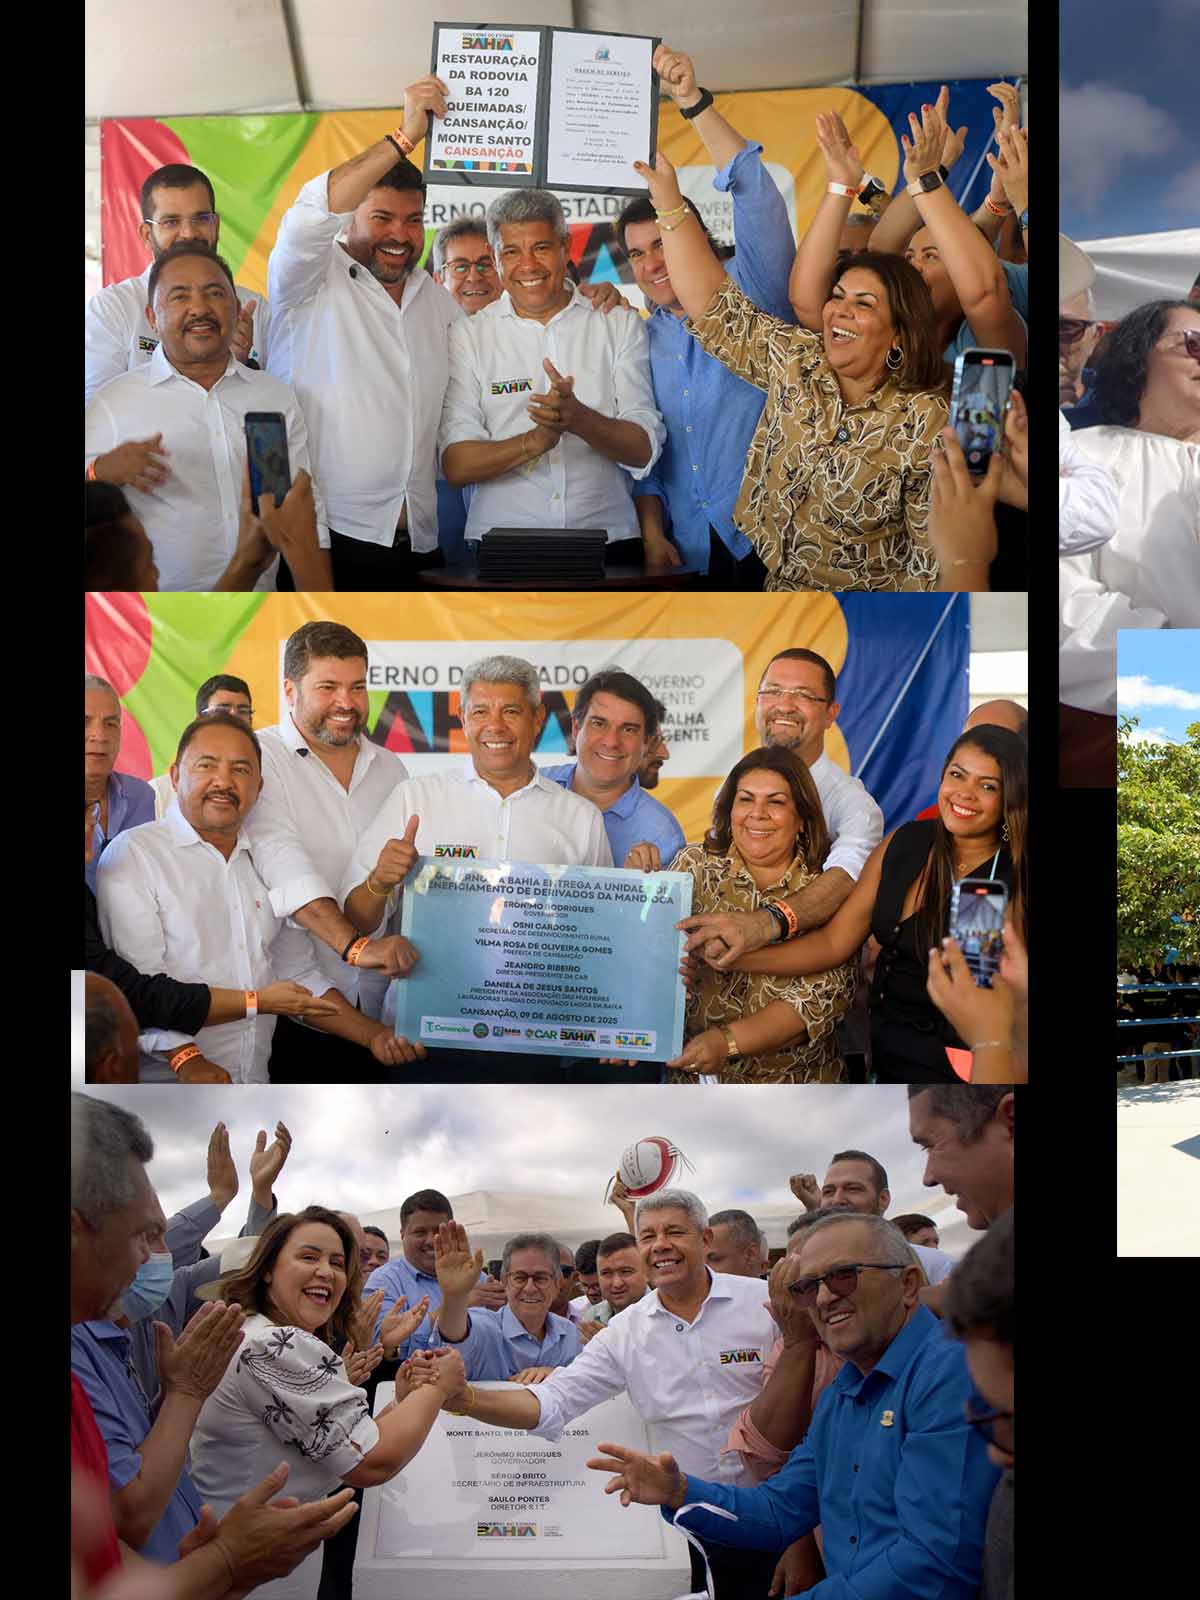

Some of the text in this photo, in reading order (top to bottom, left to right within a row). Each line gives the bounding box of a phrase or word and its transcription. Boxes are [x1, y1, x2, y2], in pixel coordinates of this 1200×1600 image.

[462, 37, 513, 50] BAHIA
[442, 54, 537, 67] RESTAURAÇÃO
[449, 70, 528, 82] DA RODOVIA
[465, 86, 510, 97] BA 120
[447, 102, 527, 114] QUEIMADAS/
[443, 118, 528, 131] CANSANÇÃO/
[437, 134, 532, 146] MONTE SANTO
[444, 146, 524, 159] CANSANÇÃO
[369, 666, 439, 685] ERNO
[640, 674, 705, 688] OVERNO
[434, 847, 480, 858] BAHIA
[507, 876, 540, 887] BAHIA
[594, 882, 601, 890] A
[428, 880, 674, 905] ENEFICIAMENTO DE DERIVADOS DA MANDOCA
[512, 921, 578, 932] OSNI CARDOSO
[503, 940, 526, 949] ROSA
[541, 943, 580, 952] OLIVEIRA
[582, 946, 613, 954] GOMES
[504, 961, 546, 970] JEANDRO
[484, 980, 598, 994] DANIELA DE JESUS SANTOS
[520, 1010, 530, 1018] 09
[531, 1012, 543, 1020] DE
[546, 1013, 582, 1022] AGOSTO
[584, 1015, 597, 1023] DE
[597, 1016, 619, 1025] 2025
[534, 1029, 558, 1039] CAR
[560, 1030, 597, 1042] BAHIA
[720, 1351, 761, 1364] BAHIA
[522, 1472, 547, 1480] BRITO
[516, 1480, 587, 1488] INFRAESTRUTURA
[488, 1495, 550, 1503] SAULO PONTES
[490, 1503, 527, 1511] DIRETOR
[477, 1526, 537, 1536] BAHIA
